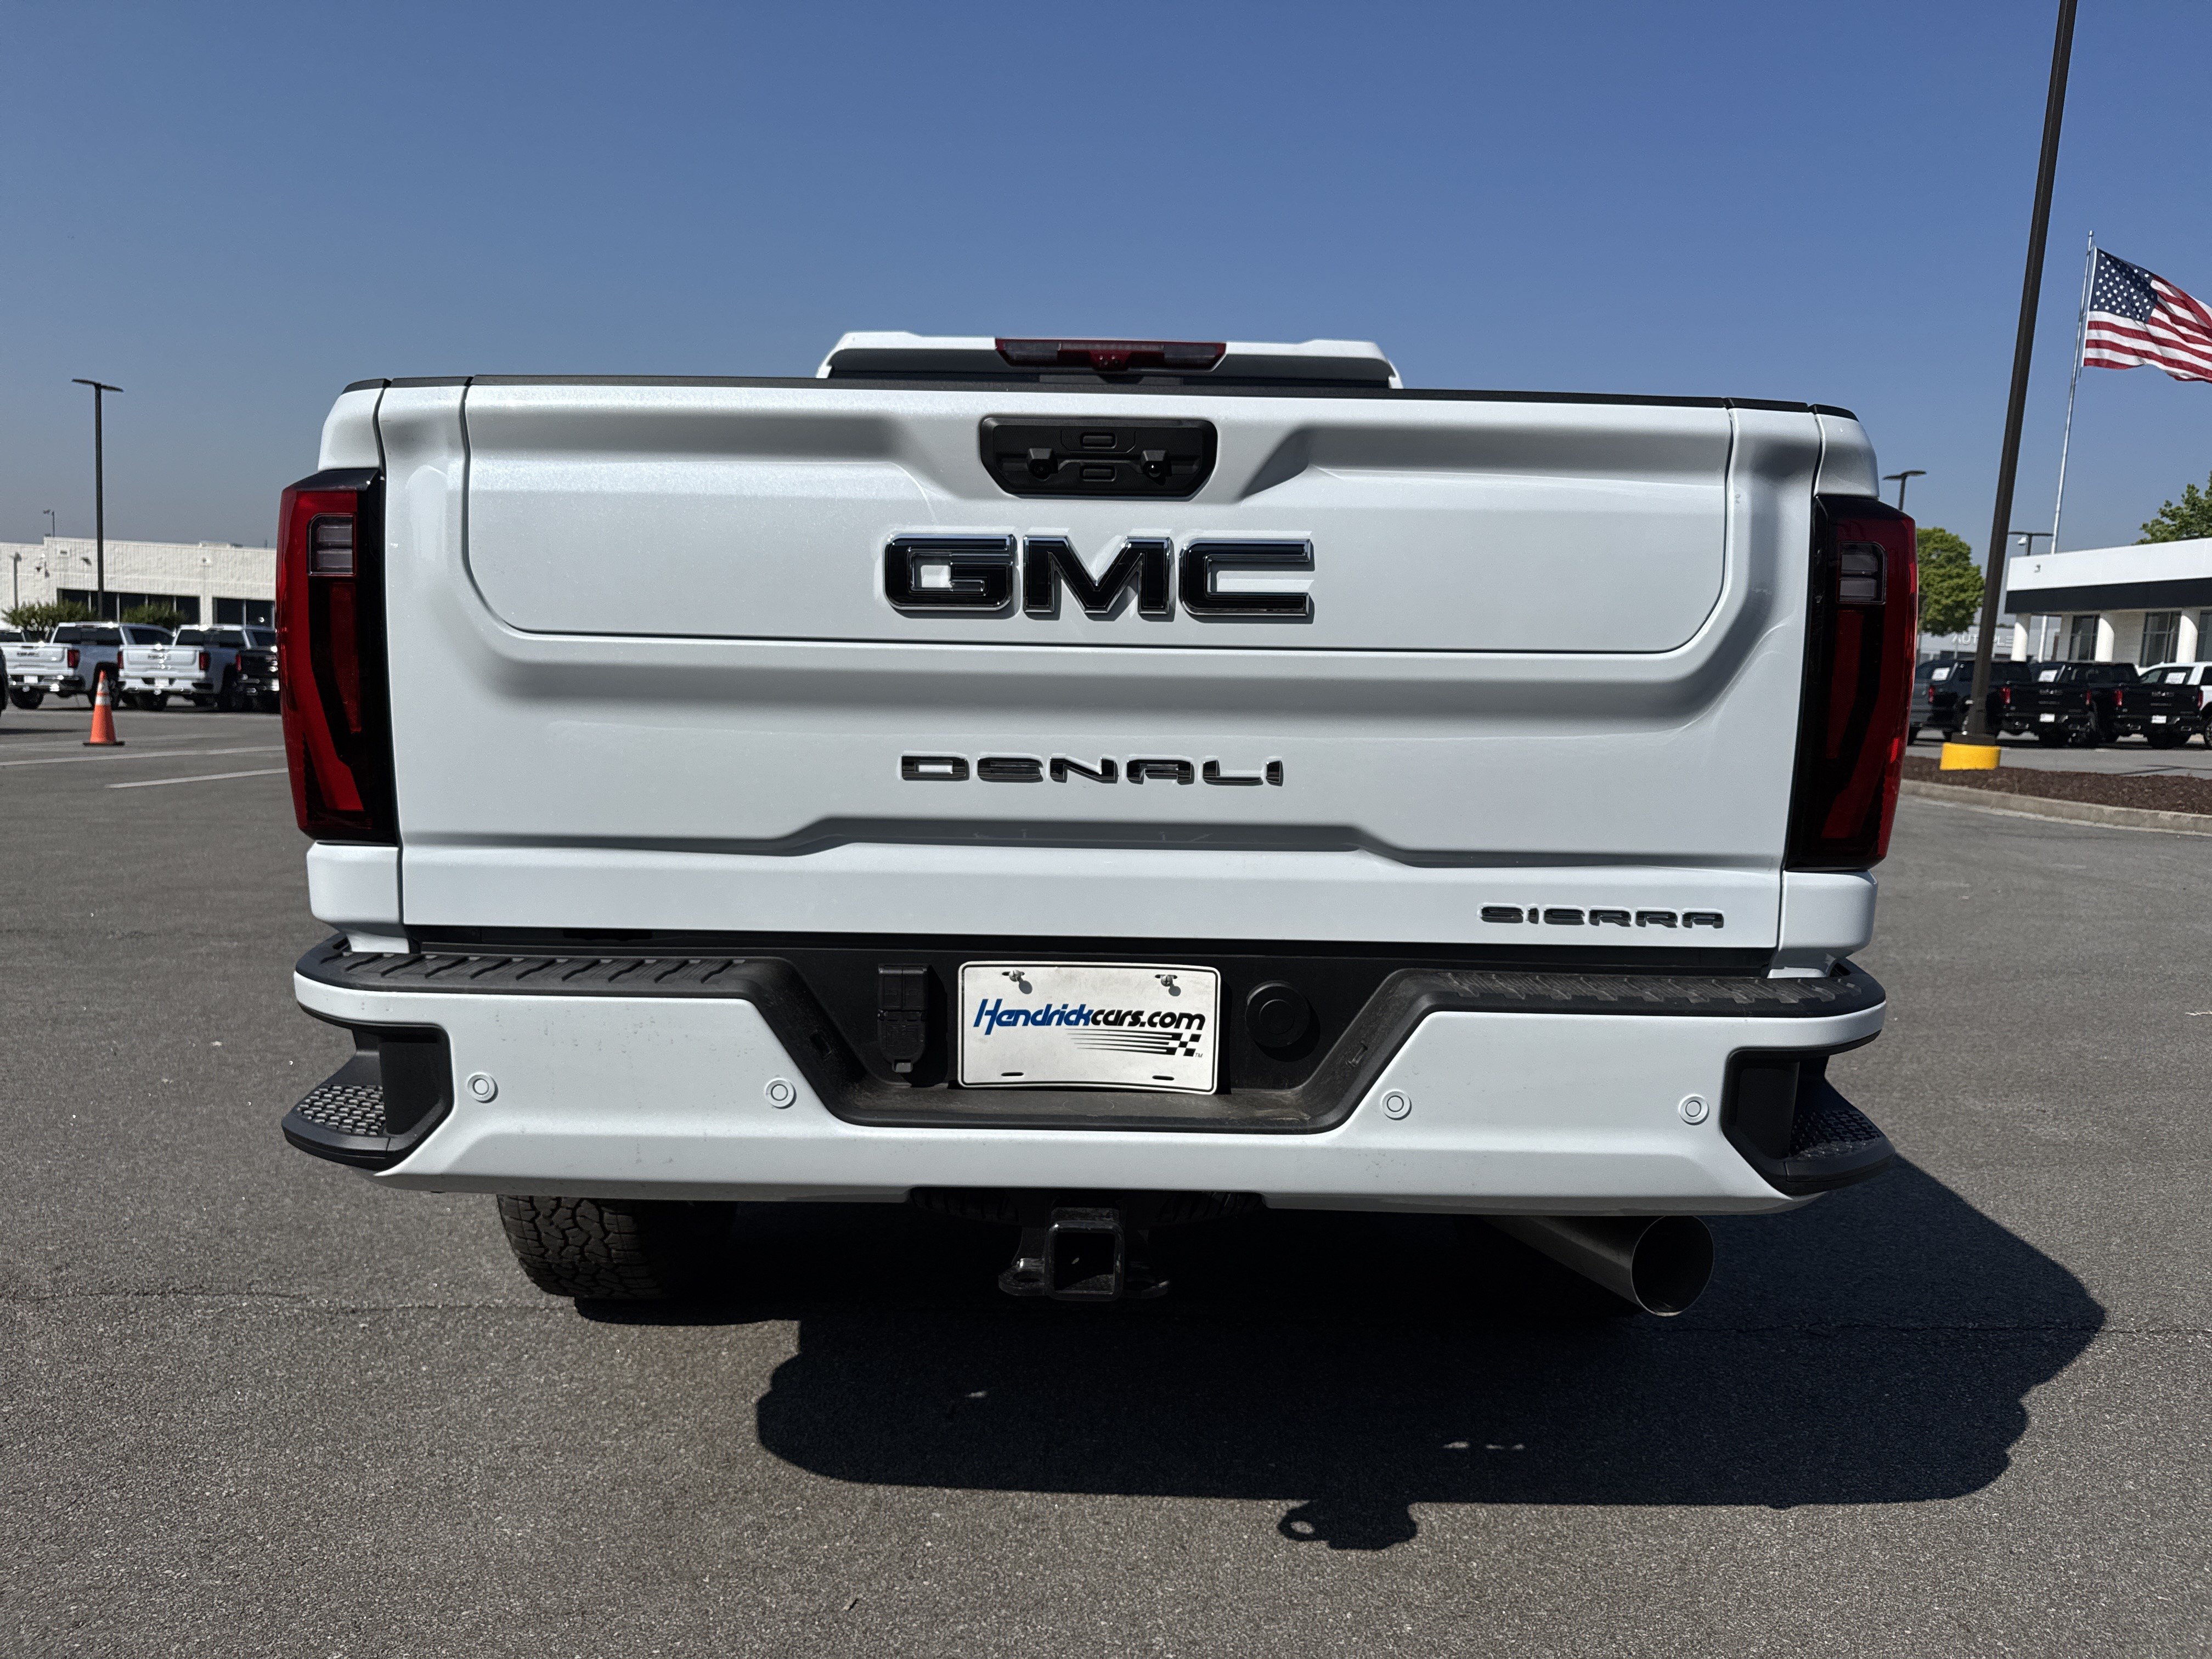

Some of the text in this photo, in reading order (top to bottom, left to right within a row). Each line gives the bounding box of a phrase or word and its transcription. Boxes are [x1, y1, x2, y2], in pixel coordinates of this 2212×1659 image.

[884, 534, 1312, 615] GMC
[901, 754, 1283, 786] DENALI
[1480, 906, 1724, 928] SIERRA
[973, 998, 1206, 1036] Hendrickcars.com
